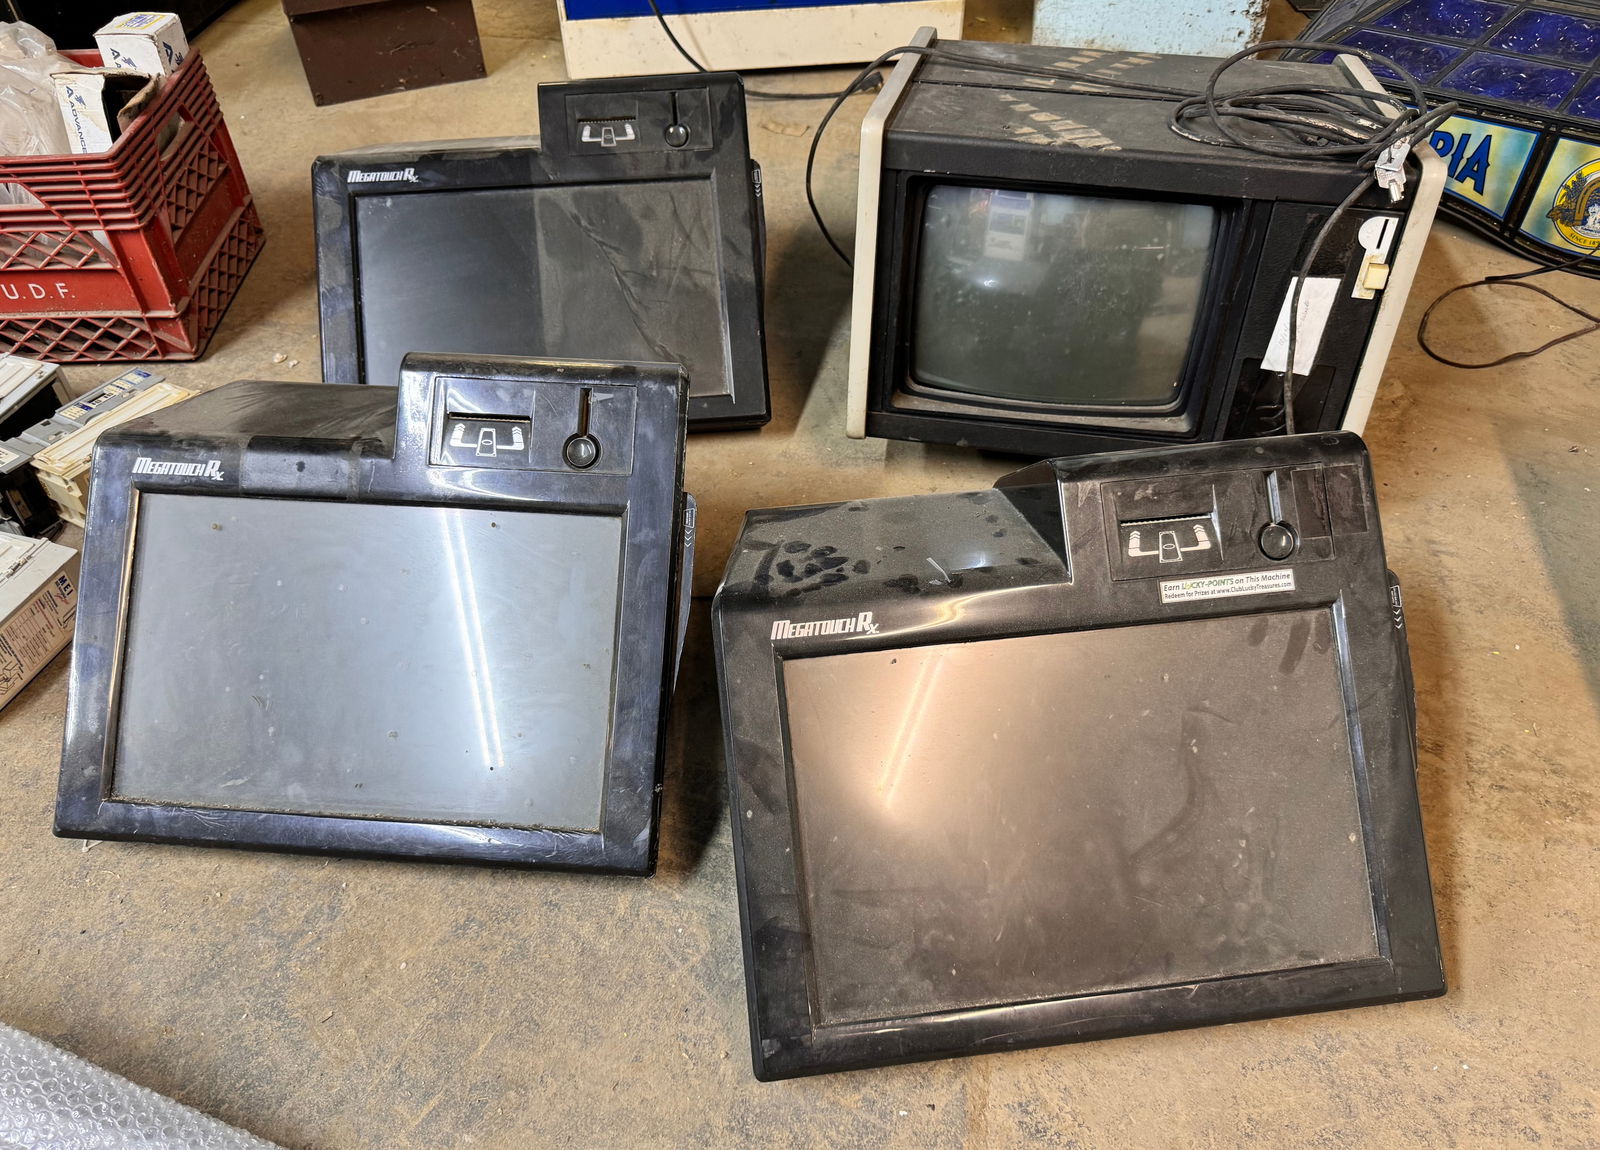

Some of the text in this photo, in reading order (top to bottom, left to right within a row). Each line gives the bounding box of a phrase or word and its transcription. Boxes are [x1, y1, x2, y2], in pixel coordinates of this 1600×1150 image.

[58, 575, 74, 596] MEI
[1163, 584, 1180, 592] Earn
[1245, 575, 1260, 584] This
[1261, 572, 1291, 582] Machine
[1164, 581, 1292, 600] Redeem for Prizes at www.ClubLuckyTreasures.com
